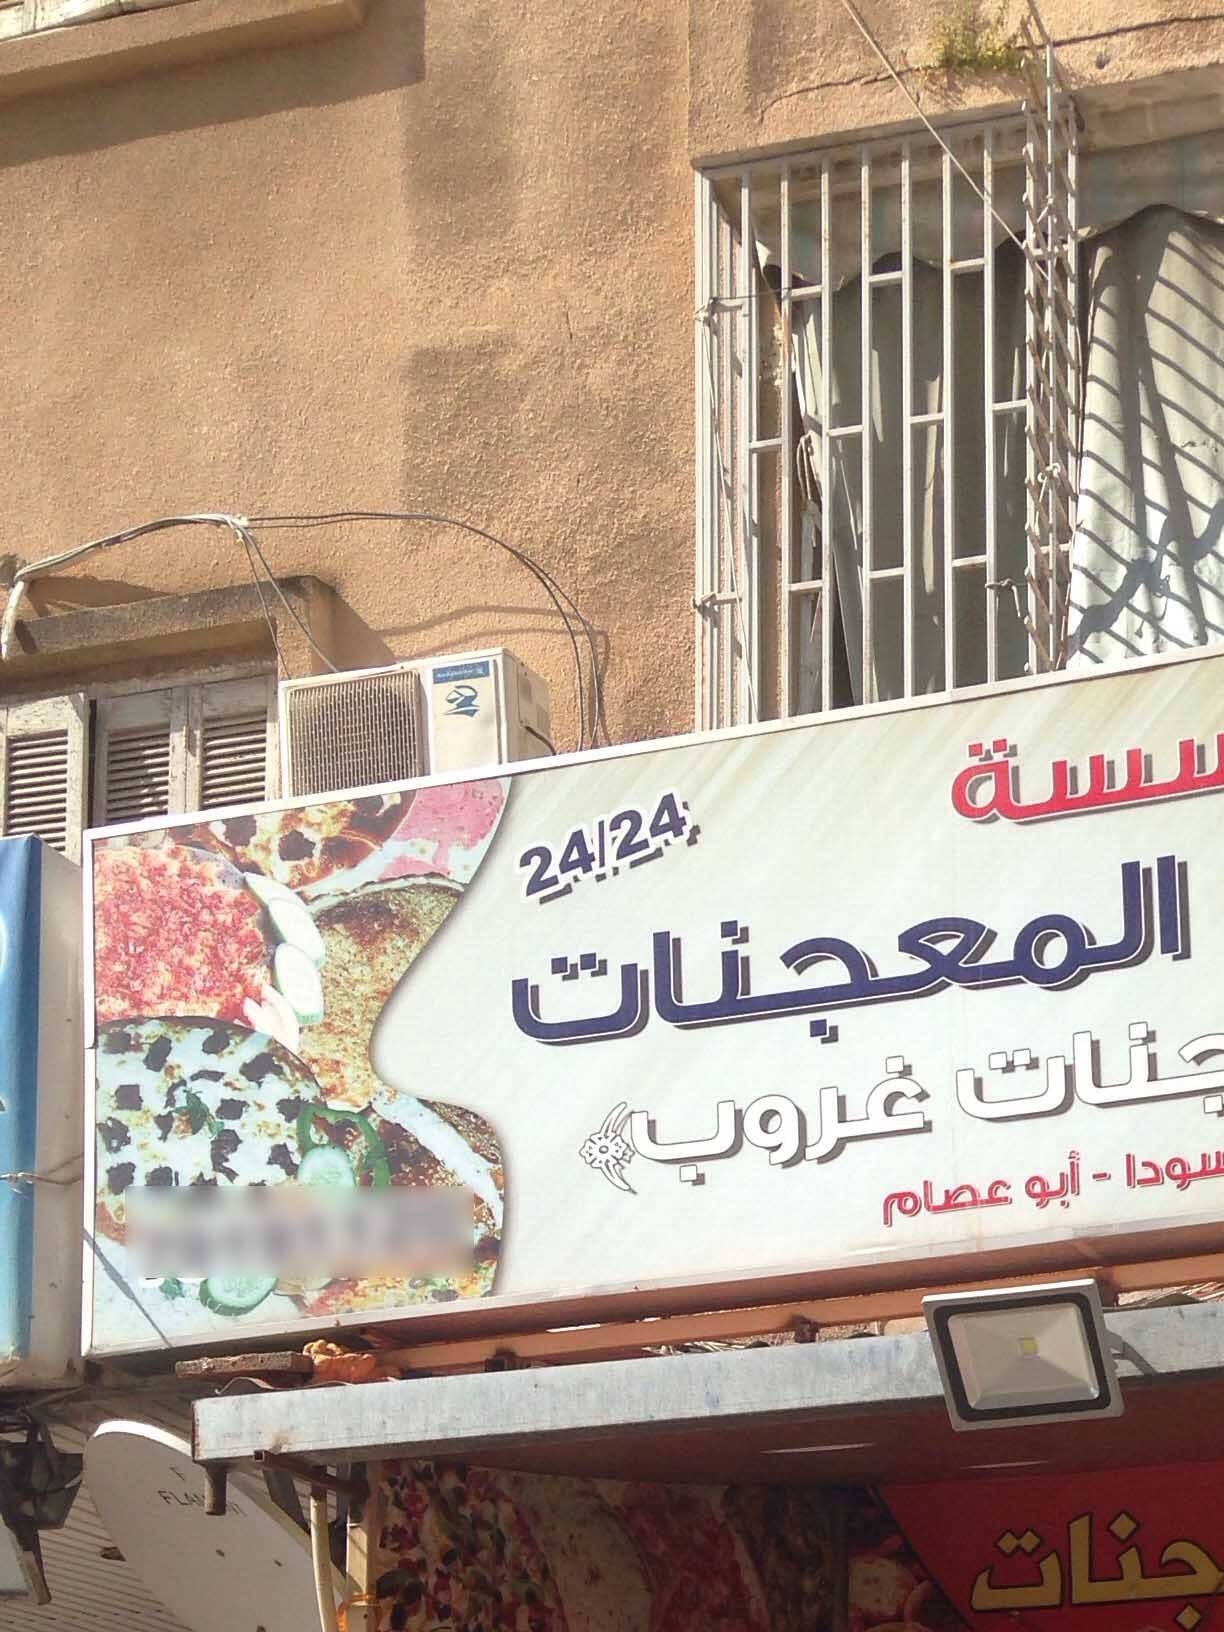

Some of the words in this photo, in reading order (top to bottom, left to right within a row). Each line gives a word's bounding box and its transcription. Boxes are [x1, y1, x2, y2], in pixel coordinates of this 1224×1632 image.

[519, 794, 694, 900] 24/24
[511, 855, 1183, 1041] المعجنات
[631, 1056, 930, 1183] غروب
[883, 1178, 1011, 1226] عصام
[1025, 1150, 1080, 1207] أبو
